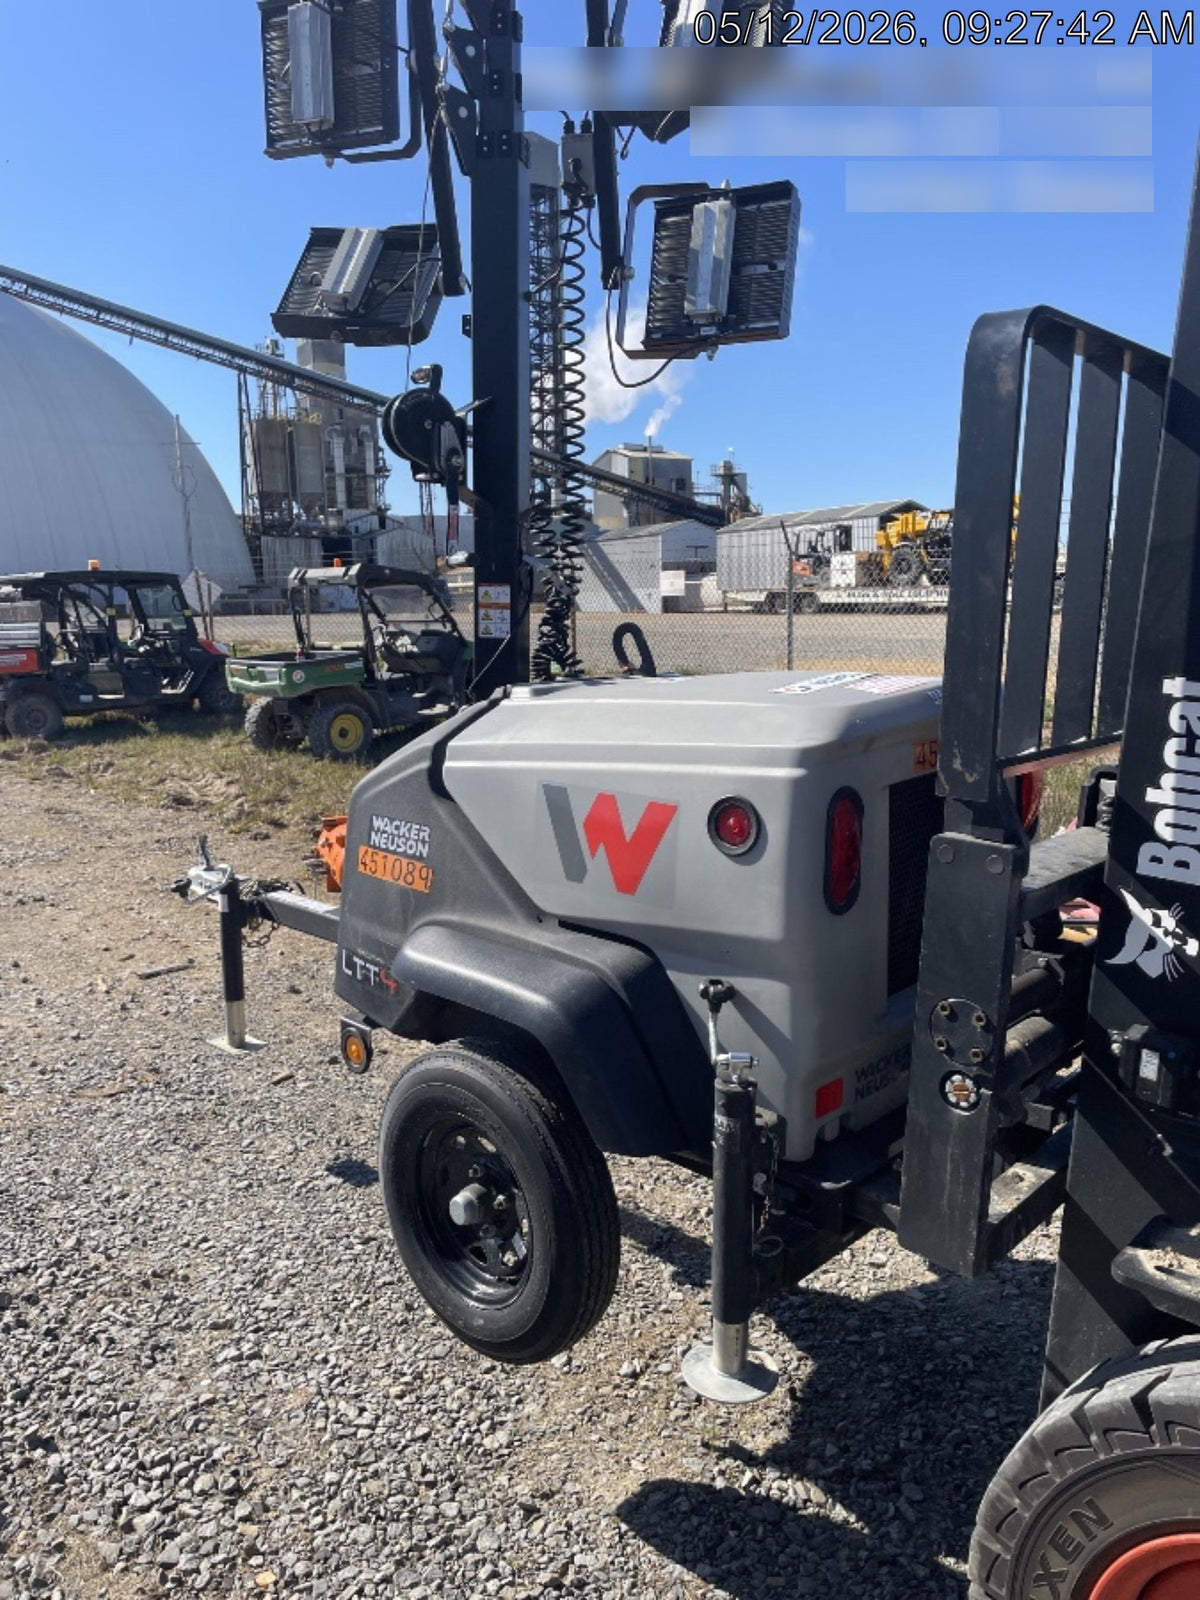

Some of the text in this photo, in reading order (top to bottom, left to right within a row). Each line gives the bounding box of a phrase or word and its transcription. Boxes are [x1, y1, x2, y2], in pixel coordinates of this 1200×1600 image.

[372, 815, 431, 842] WACKER
[370, 831, 430, 858] NEUSON
[360, 848, 430, 890] 451089
